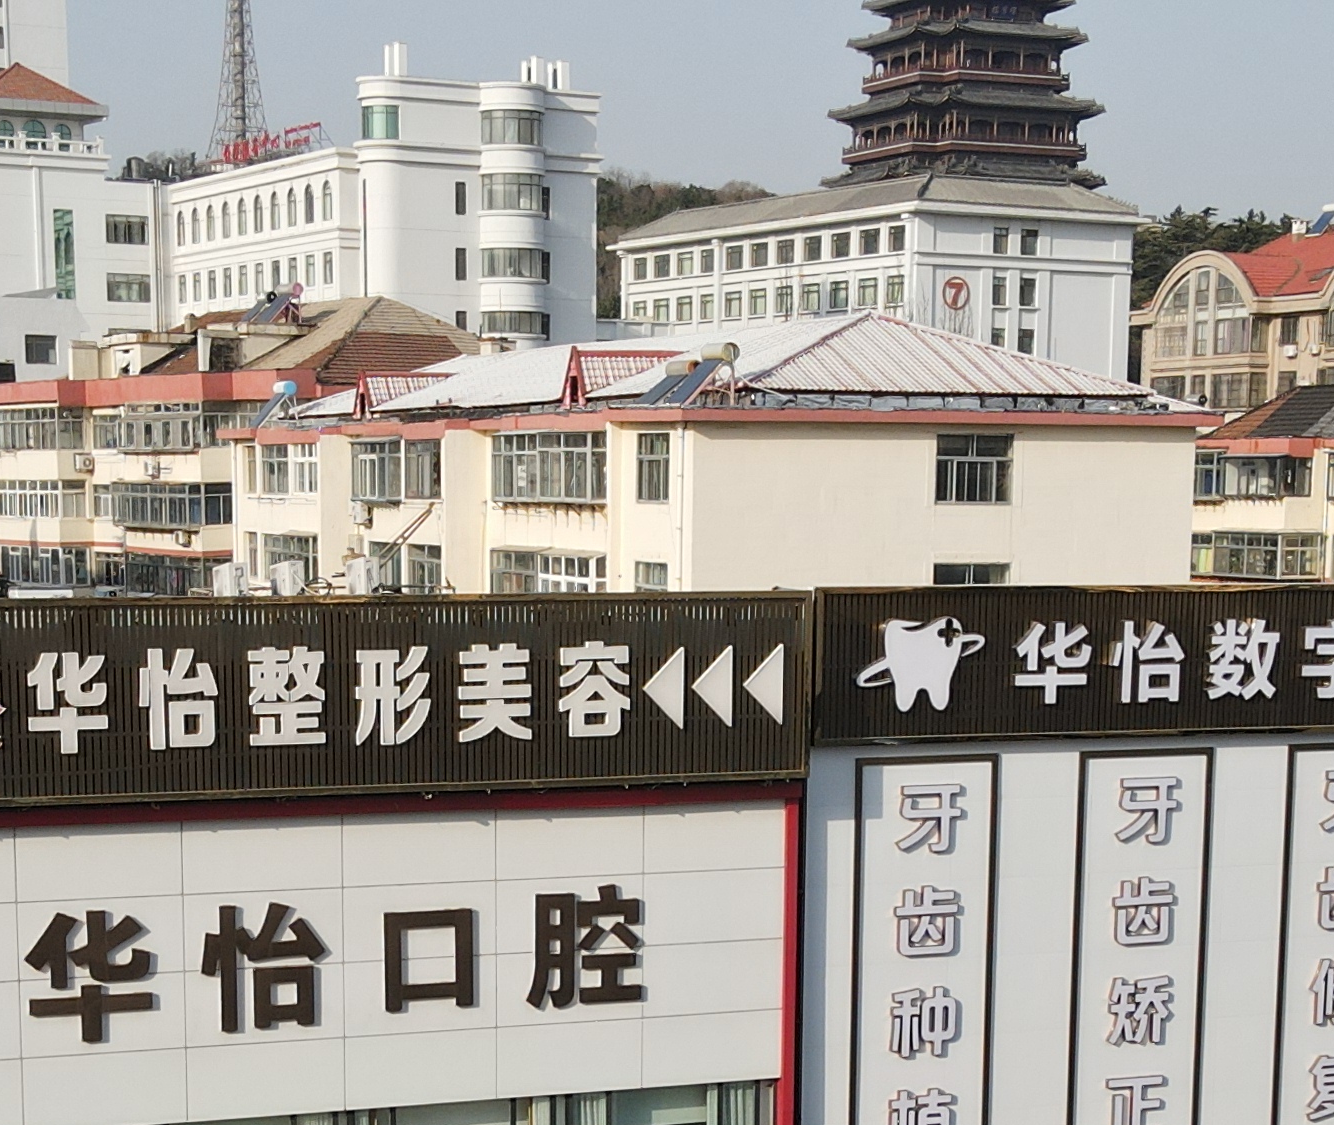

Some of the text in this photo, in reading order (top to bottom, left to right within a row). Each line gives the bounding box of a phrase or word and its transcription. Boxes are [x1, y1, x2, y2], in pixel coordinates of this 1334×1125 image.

[27, 640, 632, 755] 华怡整形美容
[24, 884, 648, 1044] 华怡口腔
